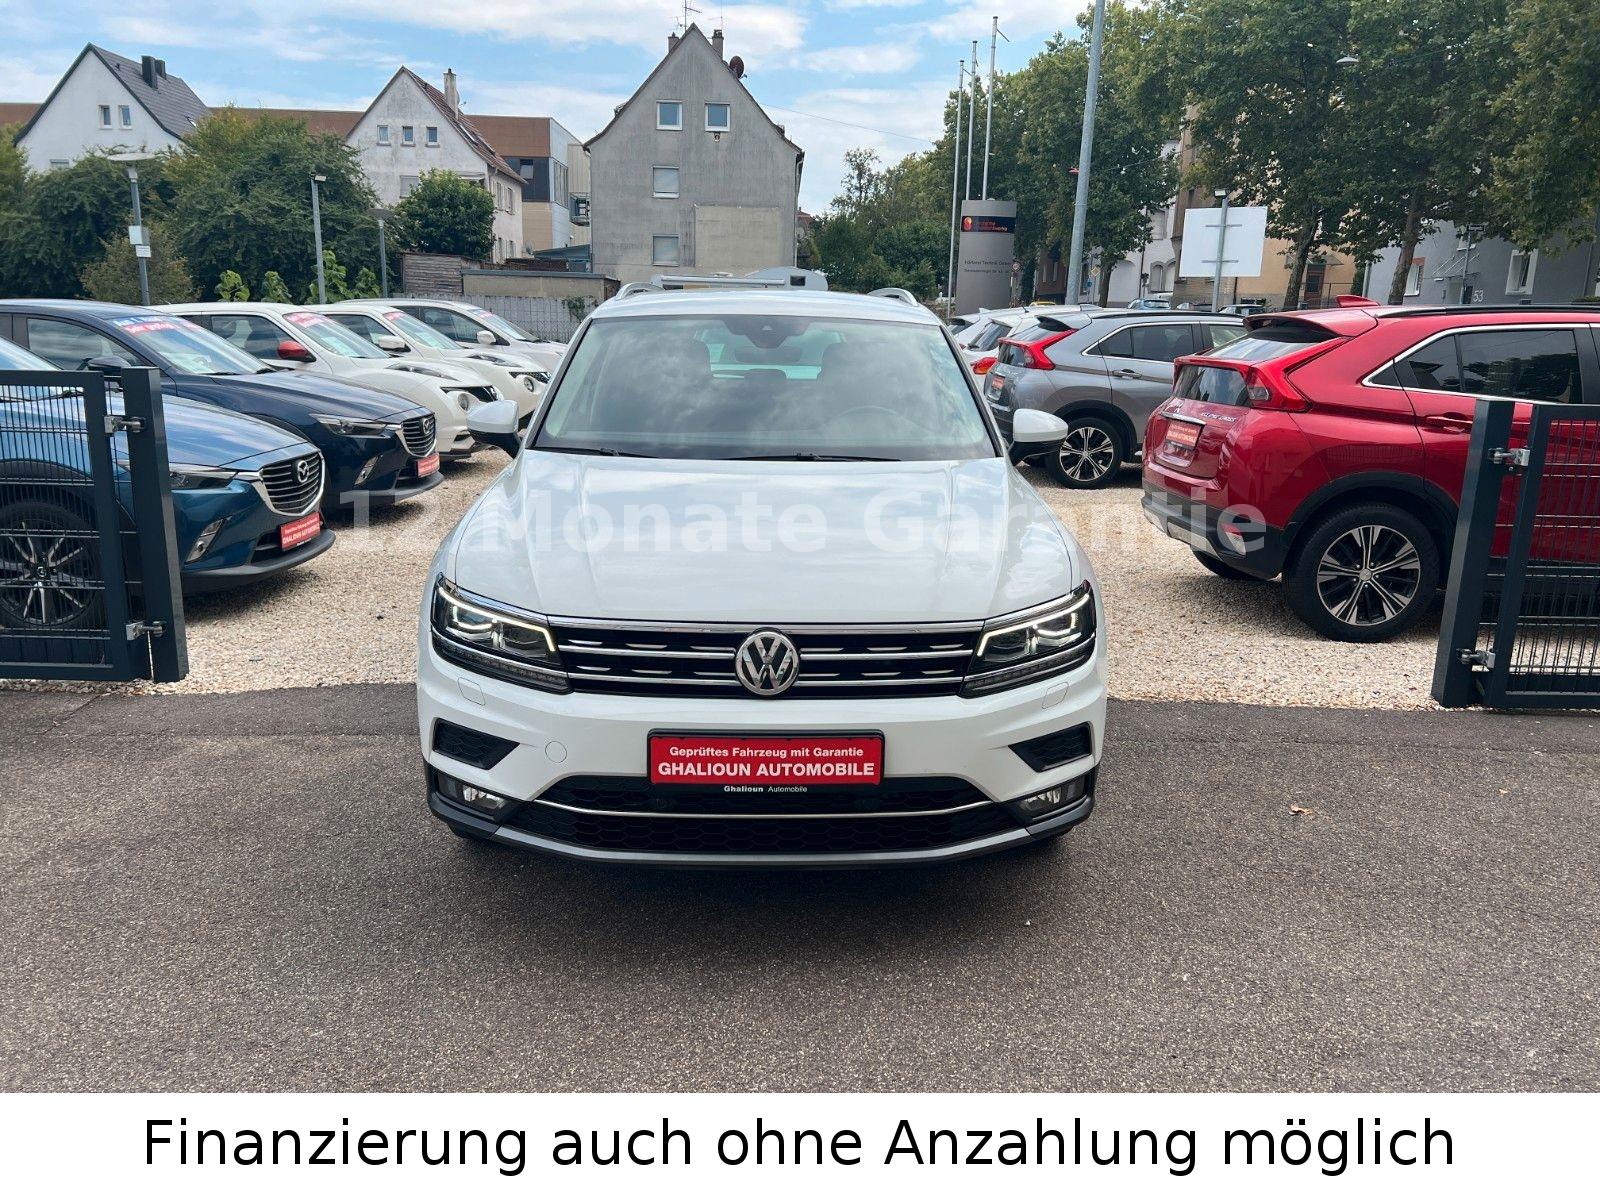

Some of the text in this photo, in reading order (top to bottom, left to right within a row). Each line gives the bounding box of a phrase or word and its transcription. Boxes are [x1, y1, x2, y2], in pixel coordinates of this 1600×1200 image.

[1473, 290, 1484, 302] 53
[669, 746, 864, 758] Geprüftes Fahrzeug mit Garantie
[657, 762, 875, 776] GHALIOUN AUTOMOBILE
[723, 785, 808, 793] Ghalioun Automobile
